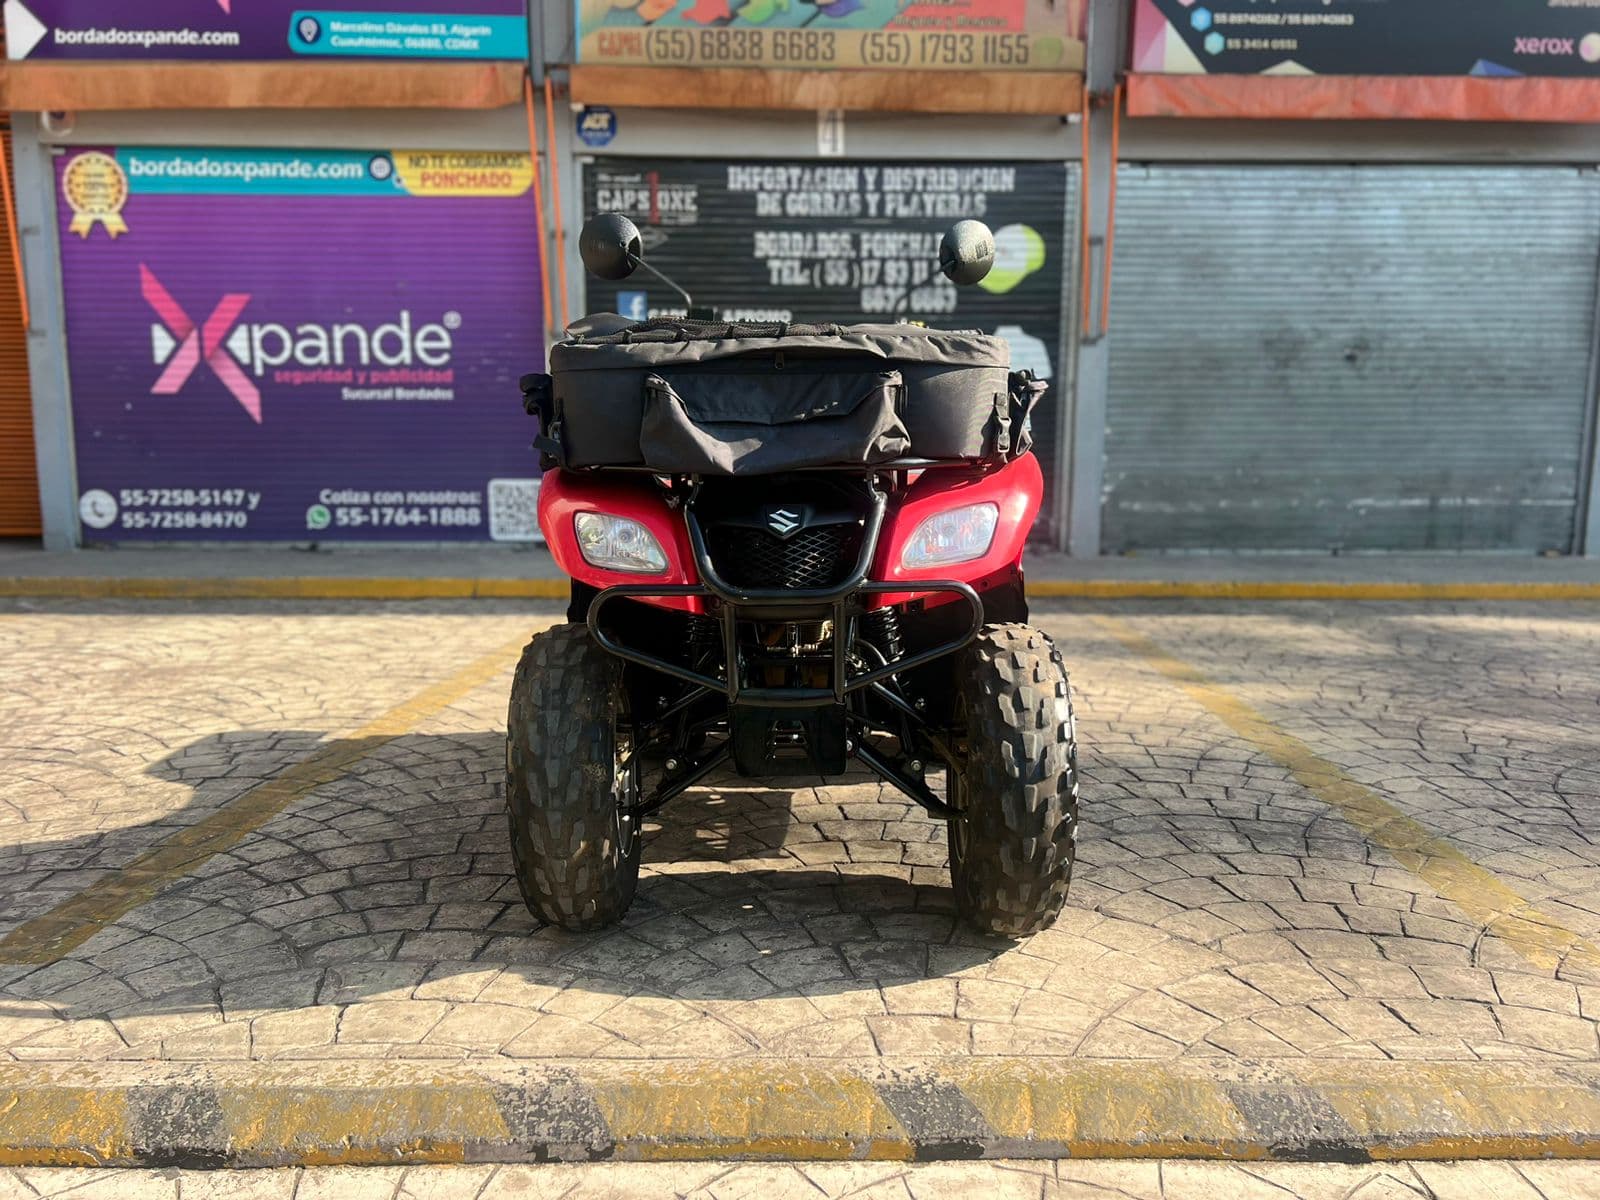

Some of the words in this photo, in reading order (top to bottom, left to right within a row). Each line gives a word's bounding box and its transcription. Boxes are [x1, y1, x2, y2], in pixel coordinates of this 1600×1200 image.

[55, 27, 240, 47] bordadosxpande.com
[645, 29, 695, 65] (55)
[700, 31, 764, 61] 6838
[772, 31, 837, 61] 6683
[1513, 36, 1574, 55] xerox
[860, 33, 911, 65] (55)
[920, 34, 975, 64] 1793
[982, 34, 1030, 65] 1155
[129, 156, 364, 183] bordadosxpande.com
[408, 154, 429, 169] NO
[420, 171, 513, 188] PONCHADO
[727, 166, 860, 192] IMPORTACION
[863, 167, 878, 192] Y
[882, 167, 1016, 193] DISTRIBUCION
[756, 191, 783, 217] DE
[785, 191, 862, 218] GORRAS
[865, 192, 881, 218] Y
[884, 192, 987, 218] PLAYERAS
[274, 367, 353, 385] seguridad
[370, 367, 454, 384] publicidad
[341, 386, 393, 400] Sucursal
[395, 387, 454, 401] Bordados
[247, 490, 262, 511] y
[319, 488, 371, 505] Cotiza
[373, 491, 405, 504] con
[335, 506, 482, 527] 55-1764-1888
